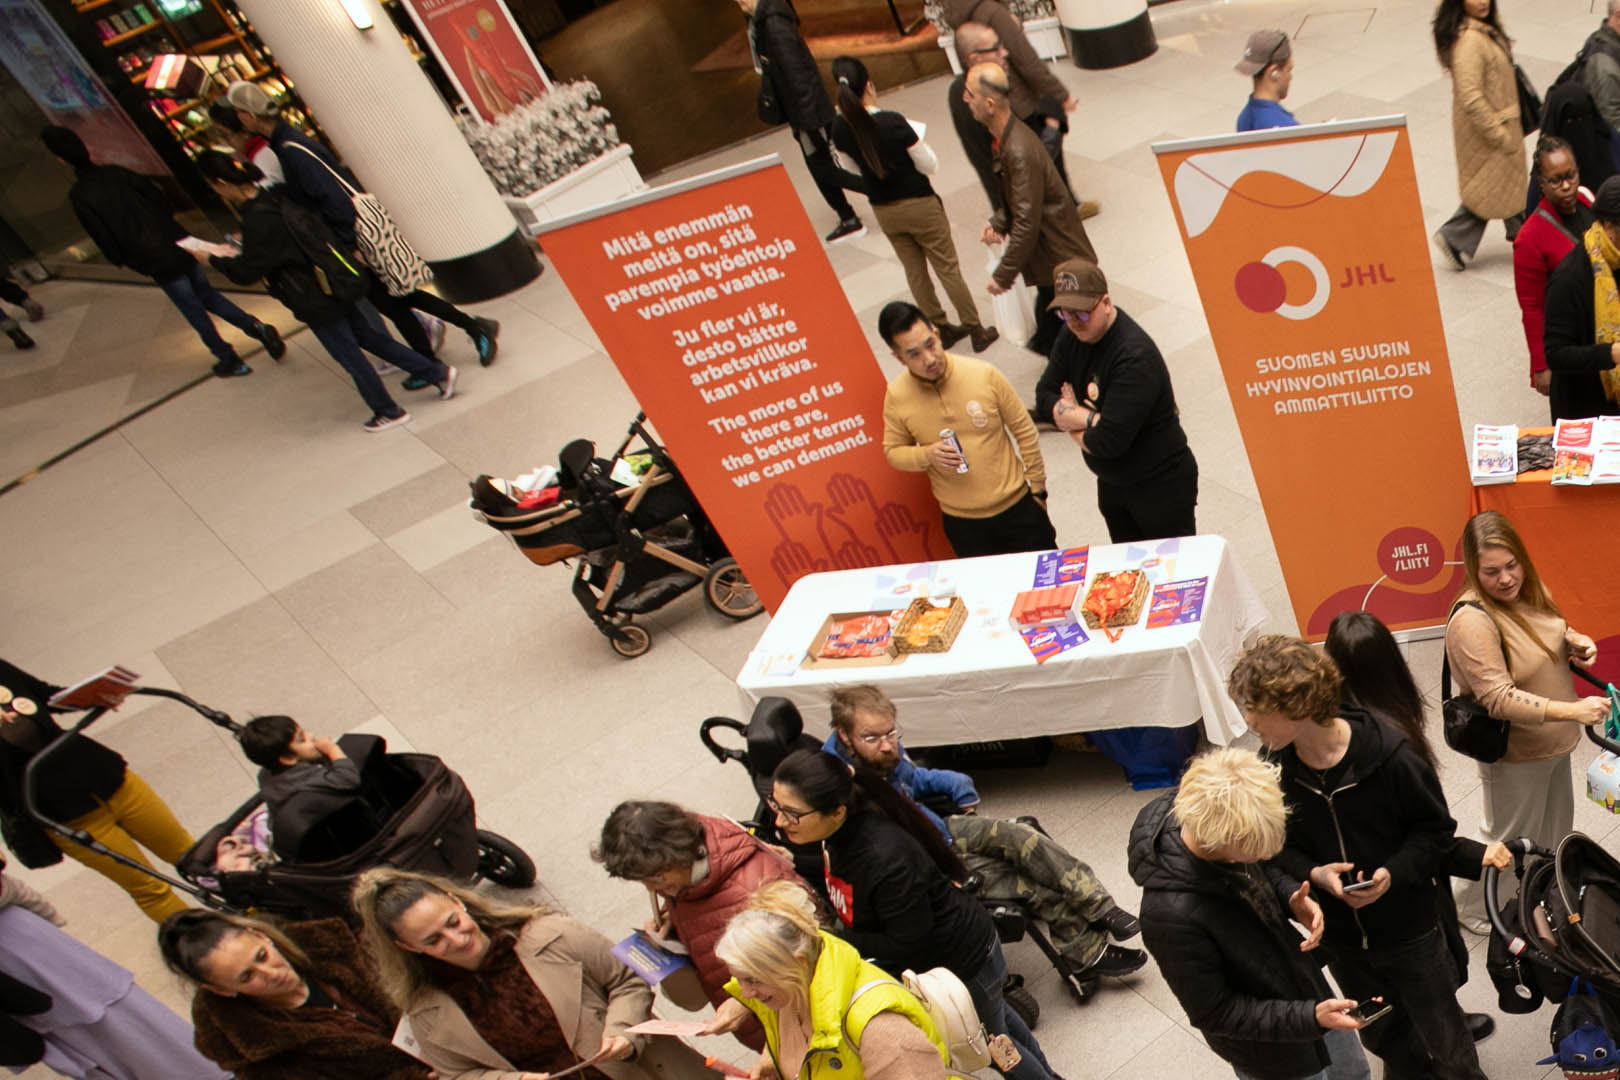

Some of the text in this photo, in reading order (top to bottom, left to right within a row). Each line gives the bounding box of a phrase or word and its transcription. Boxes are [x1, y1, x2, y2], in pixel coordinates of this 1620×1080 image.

[602, 203, 753, 260] Mitä enemmän
[623, 224, 757, 278] meitä on, sitä
[604, 237, 796, 312] parempia työehtoja
[637, 266, 785, 320] voimme vaatia.
[1339, 263, 1396, 289] JHL
[672, 302, 786, 347] Ju fler vi är,
[682, 319, 798, 366] desto bättre
[690, 336, 808, 386] arbetsvillkor
[1246, 360, 1432, 397] HYVINVOINTIALOJEN
[1255, 340, 1411, 374] SUOMEN SUURIN
[700, 358, 818, 404] kan vi kräva.
[1274, 384, 1414, 415] AMMATTILIITTO
[707, 381, 844, 435] The more of us
[740, 408, 829, 445] there are,
[721, 413, 865, 472] the better terms
[731, 430, 873, 488] we can demand.
[1392, 543, 1428, 558] JHL.FI
[1395, 556, 1429, 572] /LIITY
